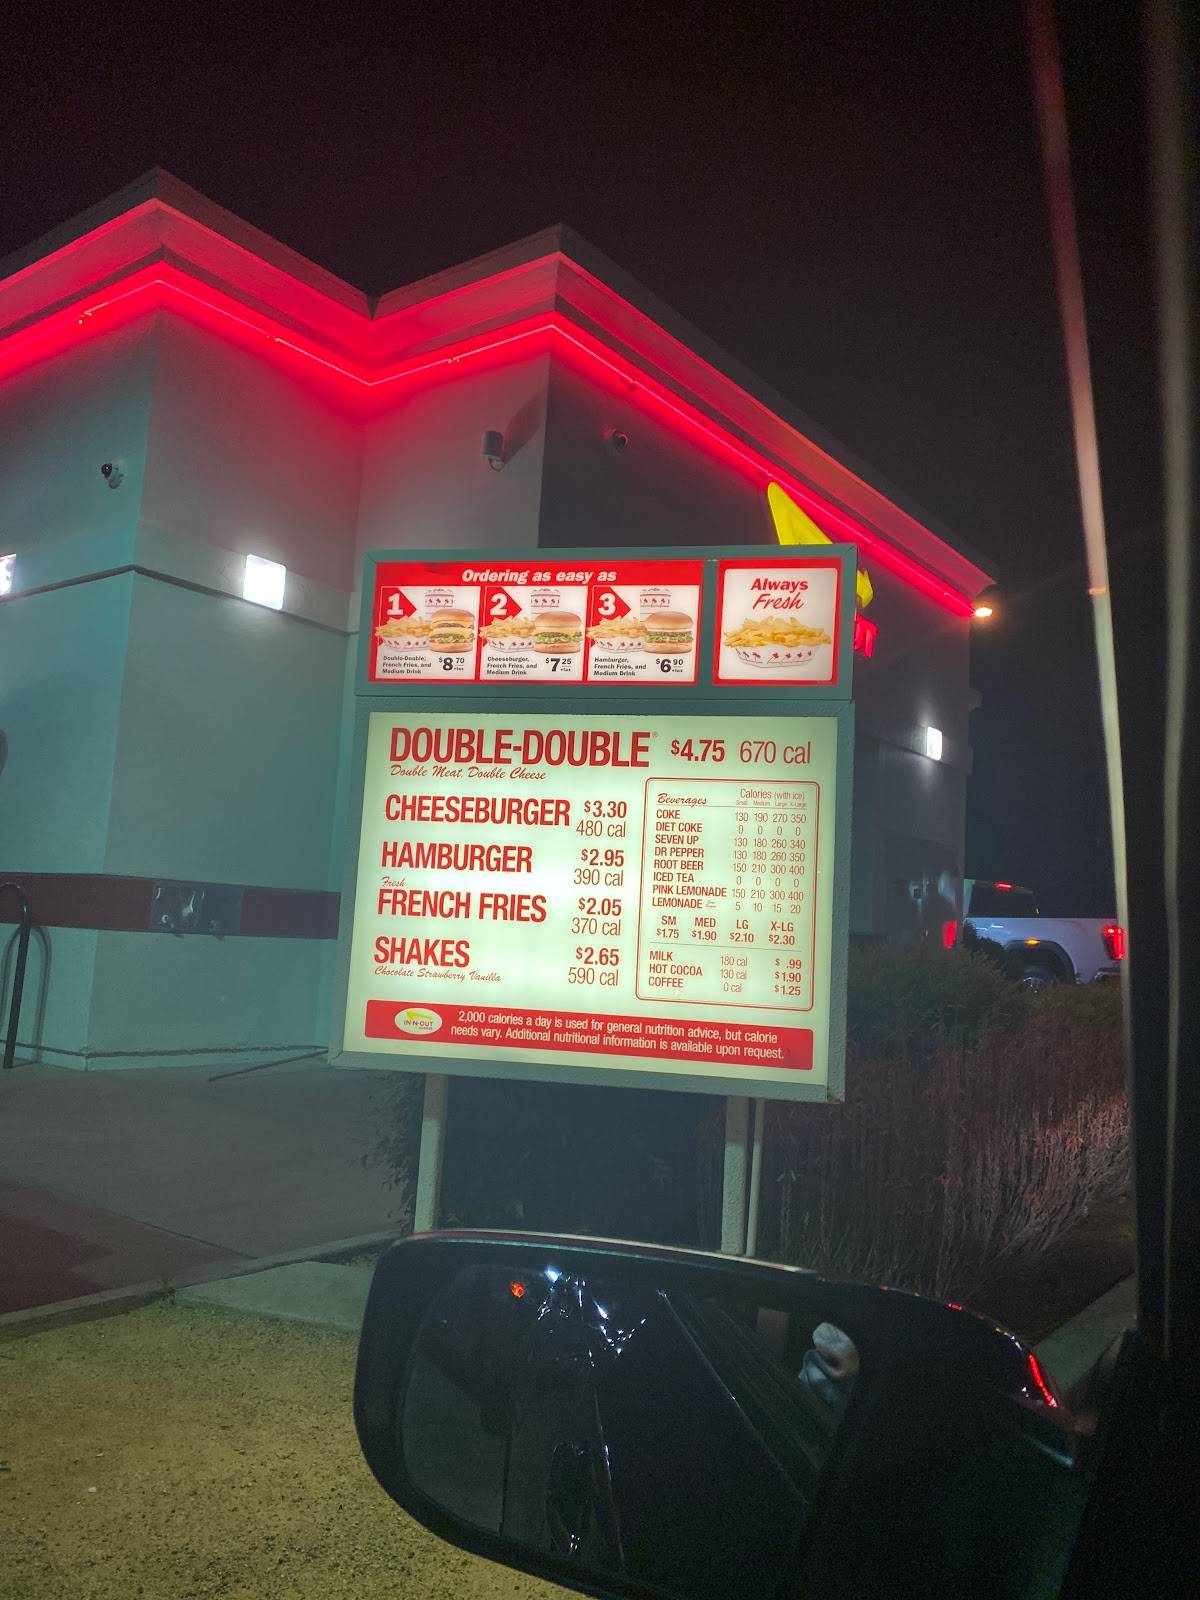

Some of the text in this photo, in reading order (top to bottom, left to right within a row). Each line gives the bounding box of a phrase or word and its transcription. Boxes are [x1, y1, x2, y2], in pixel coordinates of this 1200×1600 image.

[462, 569, 617, 584] Ordering as easy as
[750, 578, 808, 593] Always
[387, 593, 403, 615] 1
[490, 593, 508, 615] 2
[598, 593, 616, 615] 3
[752, 592, 804, 609] Fresh
[672, 658, 684, 666] 90
[390, 728, 811, 767] DOUBLE-DOUBLE $4.75 670 cal
[390, 764, 427, 777] Double
[468, 766, 504, 779] Double
[510, 767, 546, 780] Cheese
[658, 788, 805, 808] Beverages Calories (with ice)
[385, 794, 627, 826] CHEESEBURGER $3.30
[656, 809, 806, 823] COKE 130 190 270 350
[576, 820, 626, 838] 480 cal
[656, 822, 801, 836] DIET COKE 0 0 0 0
[655, 834, 806, 849] SEVEN UP 130 180 260 340
[381, 842, 625, 873] HAMBURGER $2.95
[655, 847, 805, 862] DR PEPPER 130 180 260 350
[654, 860, 804, 875] ROOT BEER 150 210 300 400
[380, 876, 405, 888] Fresh
[574, 868, 623, 887] 390 cal
[653, 872, 799, 888] ICED TEA 0 0 0 0
[653, 885, 804, 901] PINK LEMONADE 150 210 300 400
[378, 888, 622, 923] FRENCH FRIES $2.05
[652, 897, 703, 909] LEMONADE
[736, 902, 741, 911] 5
[754, 903, 762, 912] 10
[774, 904, 782, 913] 15
[790, 905, 800, 914] 20
[572, 917, 621, 936] 370 cal
[662, 916, 794, 932] SM MED LG X-LG
[656, 928, 795, 945] $1.75 $1.90 $2.10 $2.30
[374, 936, 620, 968] SHAKES $2.65
[650, 951, 802, 969] MILK 180 cal $ .99
[374, 966, 501, 982] Chocolate Strawberry Vanilla
[568, 967, 618, 986] 590 cal
[649, 963, 801, 982] HOT COCOA 130 cal $1.90
[649, 976, 801, 996] COFFEE 0 cal $1.25
[458, 1011, 778, 1044] 2,000 calories a day is used for general nutrition advice, but calorie
[451, 1026, 784, 1060] needs vary. Additional nutritional information is available upon request.
